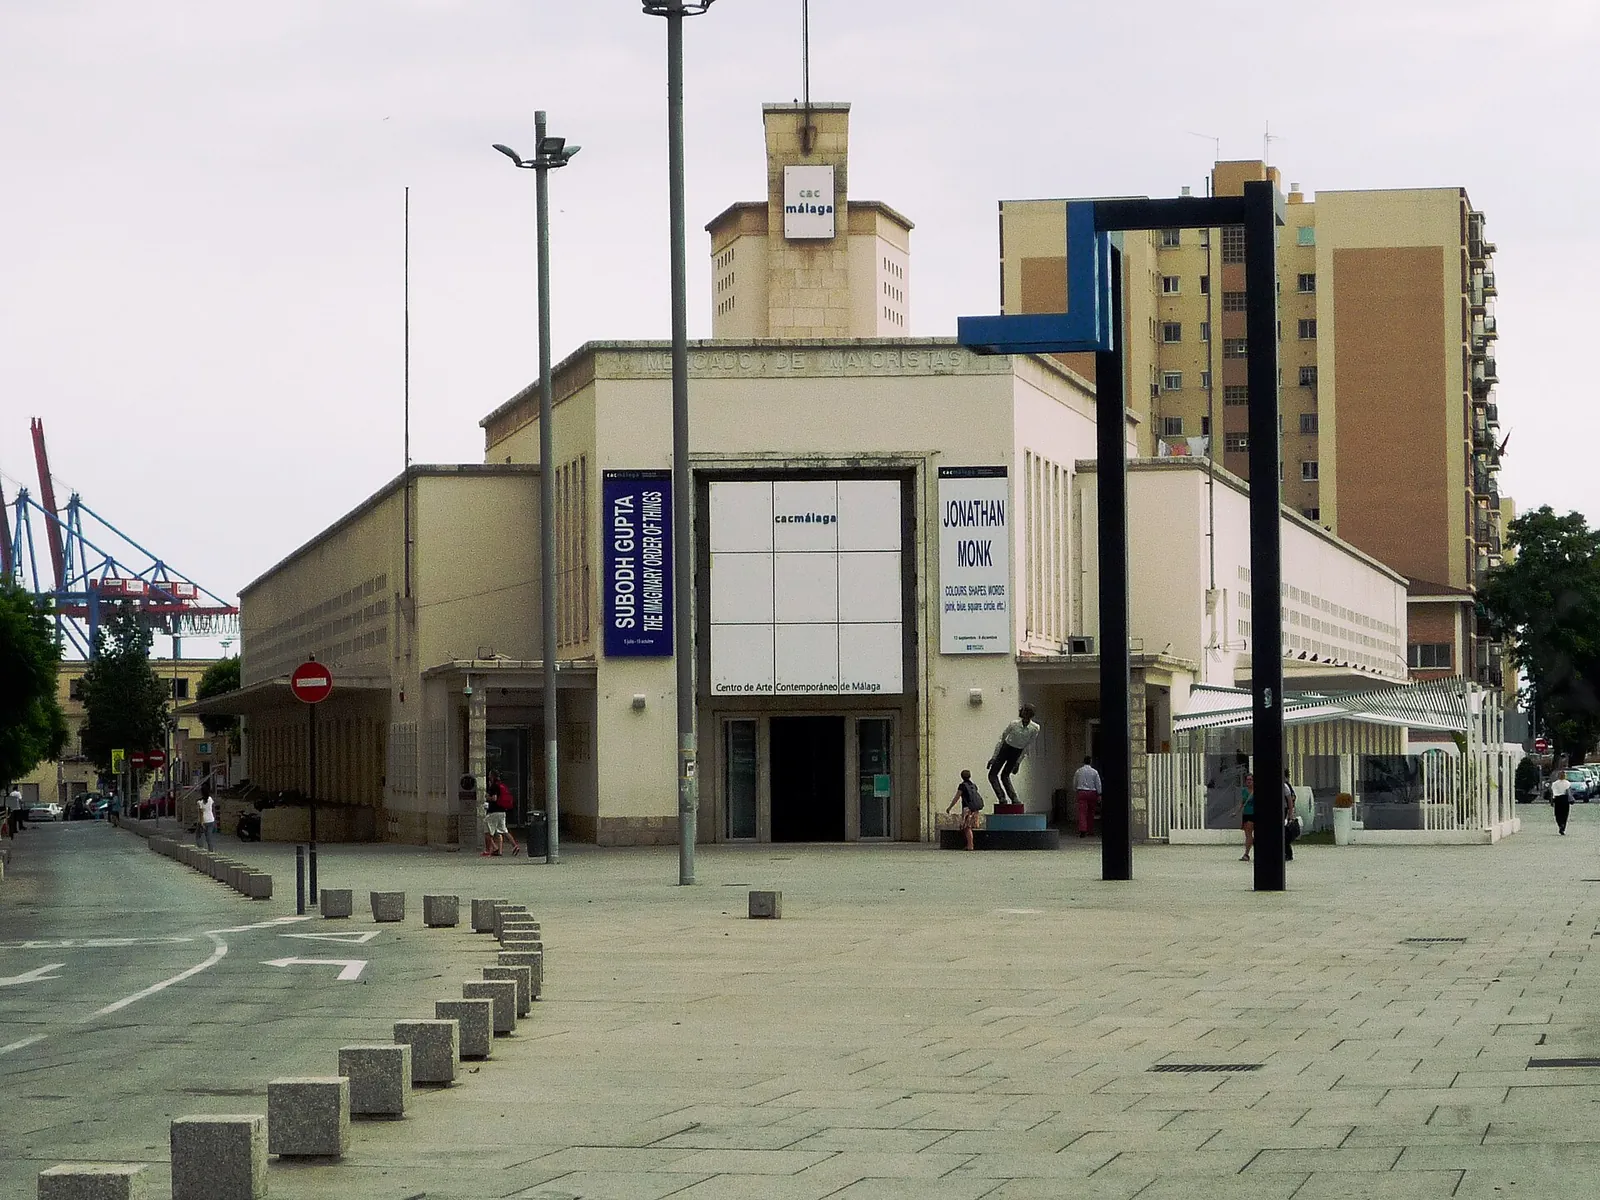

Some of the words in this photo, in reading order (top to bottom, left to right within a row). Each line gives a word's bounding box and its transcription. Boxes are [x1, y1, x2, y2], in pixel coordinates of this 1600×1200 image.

[799, 190, 820, 198] cac
[785, 203, 833, 216] málaga
[648, 353, 752, 370] MECADO
[776, 352, 805, 369] DE
[829, 351, 963, 369] MAYORISTAS
[641, 491, 662, 522] THINGS
[943, 500, 1005, 528] JONATHAN
[614, 494, 635, 552] GUPTA
[642, 523, 662, 536] OF
[774, 512, 837, 525] cacmálaga
[642, 537, 663, 566] ORDER
[957, 540, 993, 567] MONK
[614, 557, 636, 629] SUBODH
[642, 567, 663, 614] IMAGINARY
[643, 615, 663, 631] THE
[716, 683, 742, 692] Centro
[744, 683, 754, 692] de
[756, 683, 773, 692] Arte
[776, 682, 838, 693] Contemporáneo
[840, 682, 850, 691] de
[852, 682, 881, 692] Málaga
